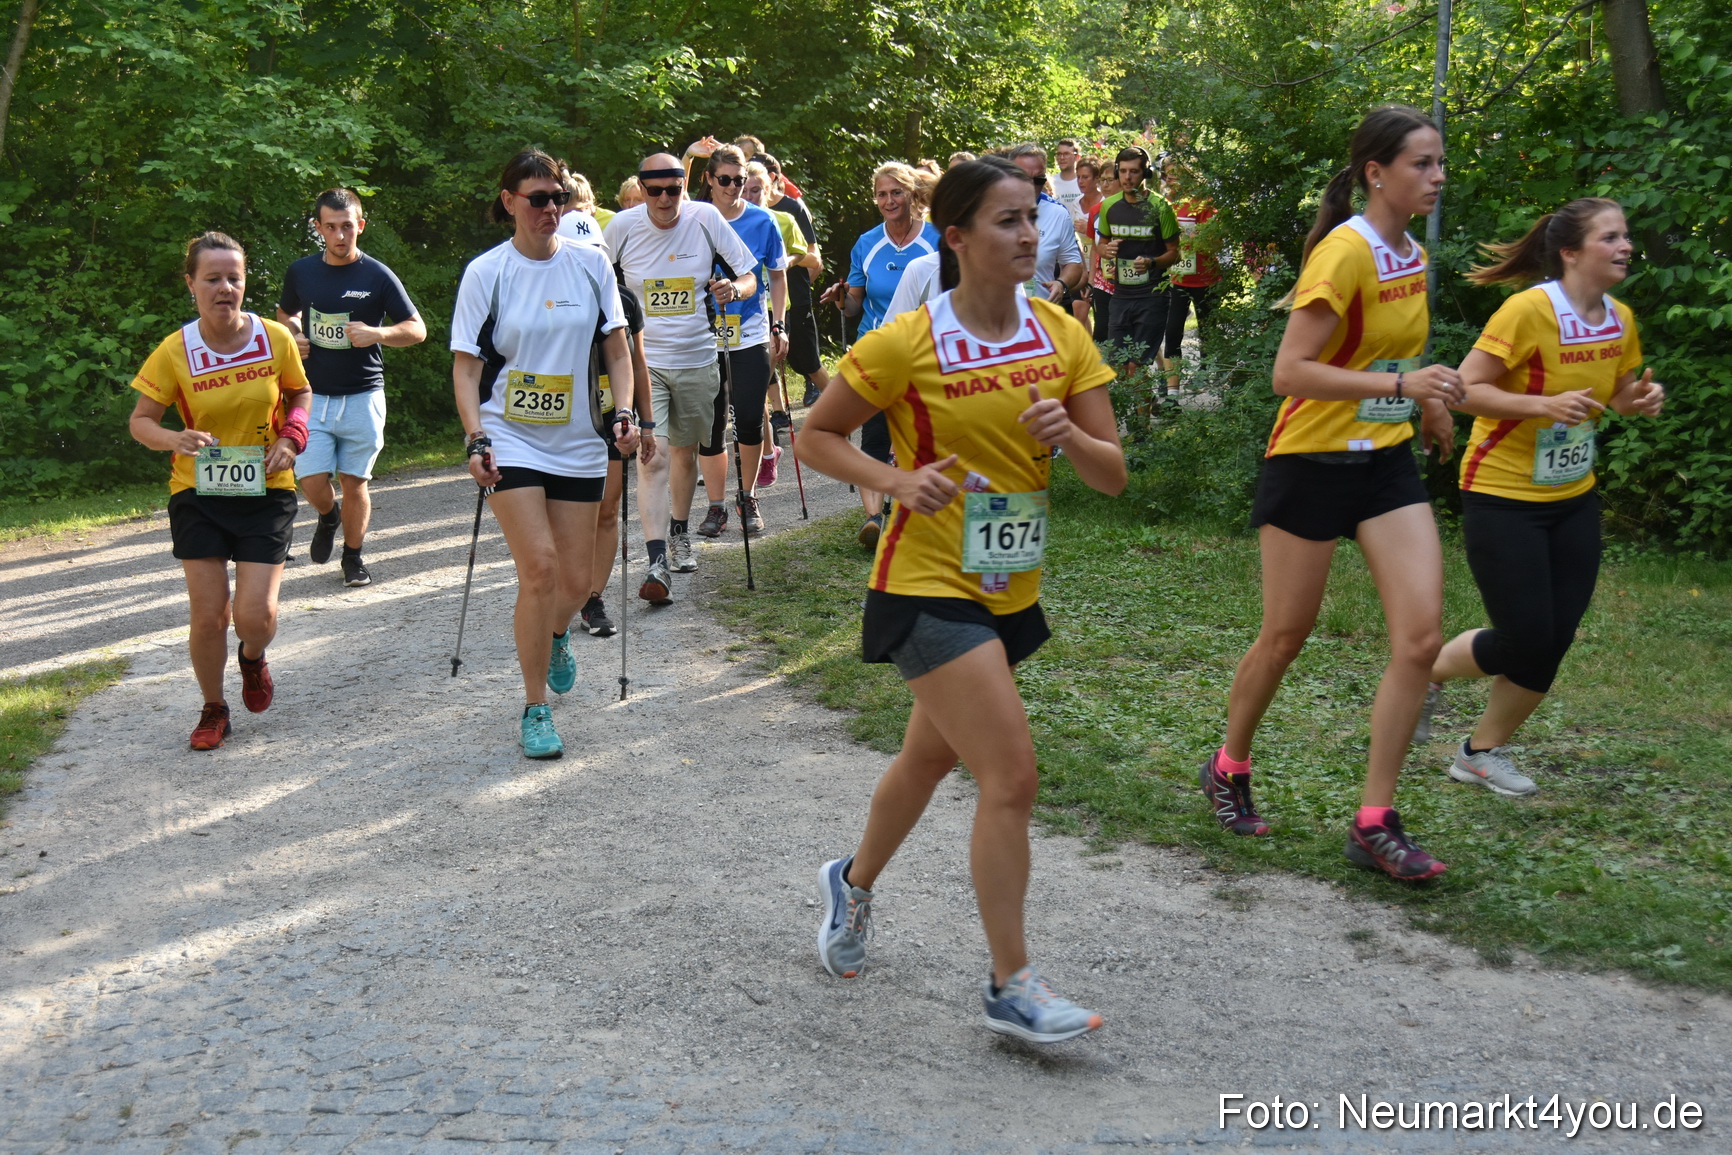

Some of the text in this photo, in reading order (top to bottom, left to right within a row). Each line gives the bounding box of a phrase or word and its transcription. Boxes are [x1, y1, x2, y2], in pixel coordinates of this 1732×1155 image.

[576, 221, 590, 235] NY
[1110, 225, 1153, 236] BOCK
[651, 291, 689, 306] 2372
[1379, 285, 1408, 304] MAX
[313, 323, 345, 340] 1408
[1560, 350, 1595, 364] MAX
[193, 366, 275, 392] MAX BÖGL
[944, 363, 1067, 400] MAX BÖGL
[513, 390, 565, 410] 2385
[1545, 442, 1589, 469] 1562
[204, 464, 256, 482] 1700
[978, 521, 1040, 551] 1674
